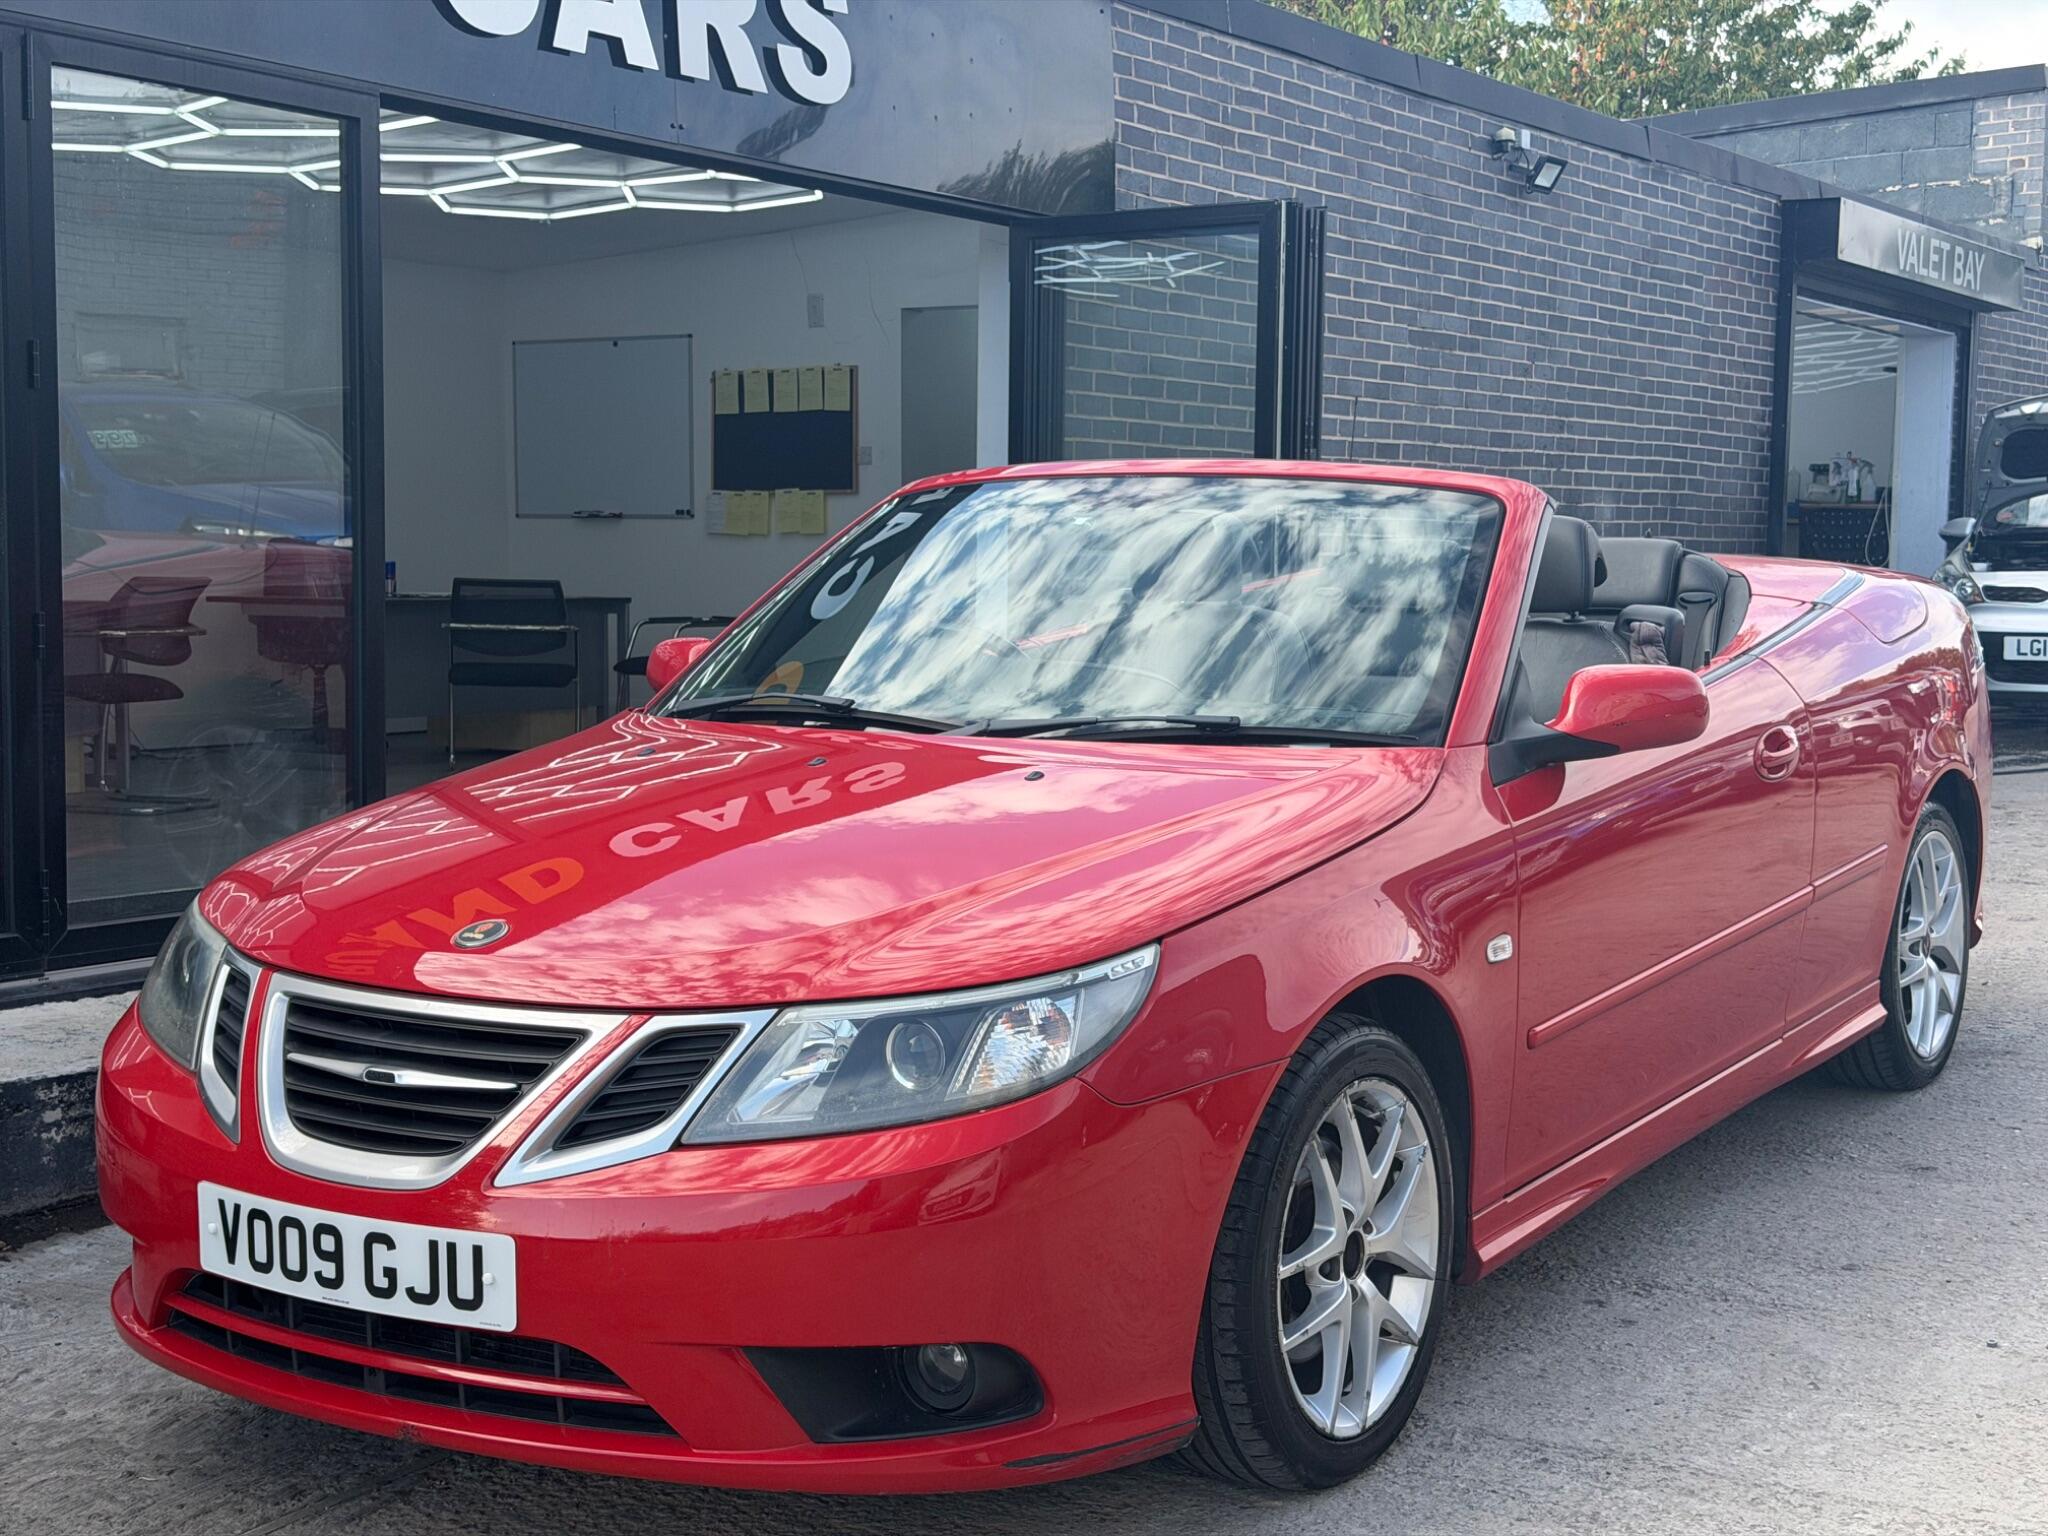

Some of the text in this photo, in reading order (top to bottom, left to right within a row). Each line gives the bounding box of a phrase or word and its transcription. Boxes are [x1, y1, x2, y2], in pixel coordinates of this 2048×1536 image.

[441, 0, 853, 105] ARS
[1897, 228, 1985, 291] VALET BAY
[363, 1231, 484, 1312] GJU
